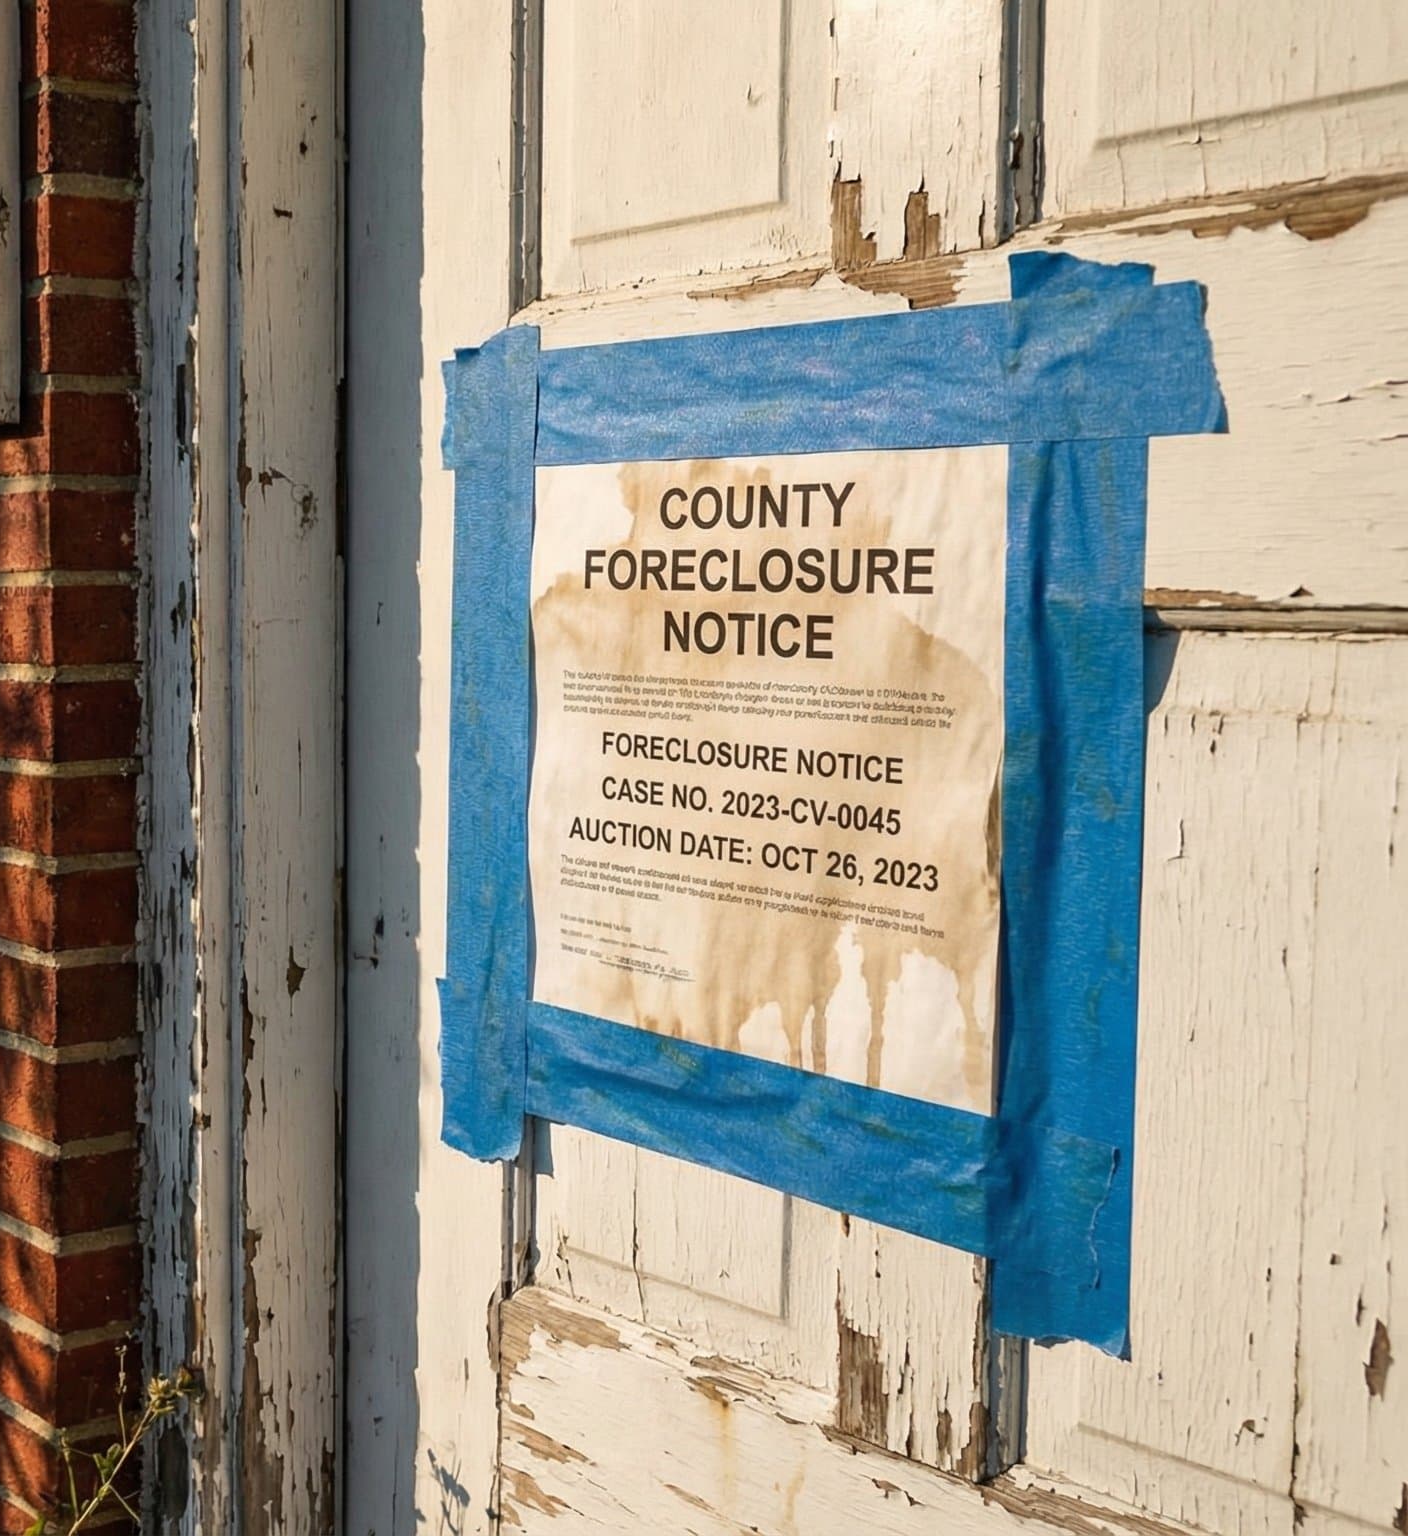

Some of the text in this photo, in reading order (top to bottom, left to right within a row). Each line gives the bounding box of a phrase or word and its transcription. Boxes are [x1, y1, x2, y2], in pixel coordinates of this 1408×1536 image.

[660, 482, 856, 530] COUNTY
[584, 548, 935, 595] FORECLOSURE
[664, 610, 834, 660] NOTICE
[602, 731, 903, 785] FORECLOSURE NOTICE
[602, 776, 901, 836] CASE NO. 2023-CV-0045
[569, 816, 939, 892] AUCTION DATE: OCT 26, 2023
